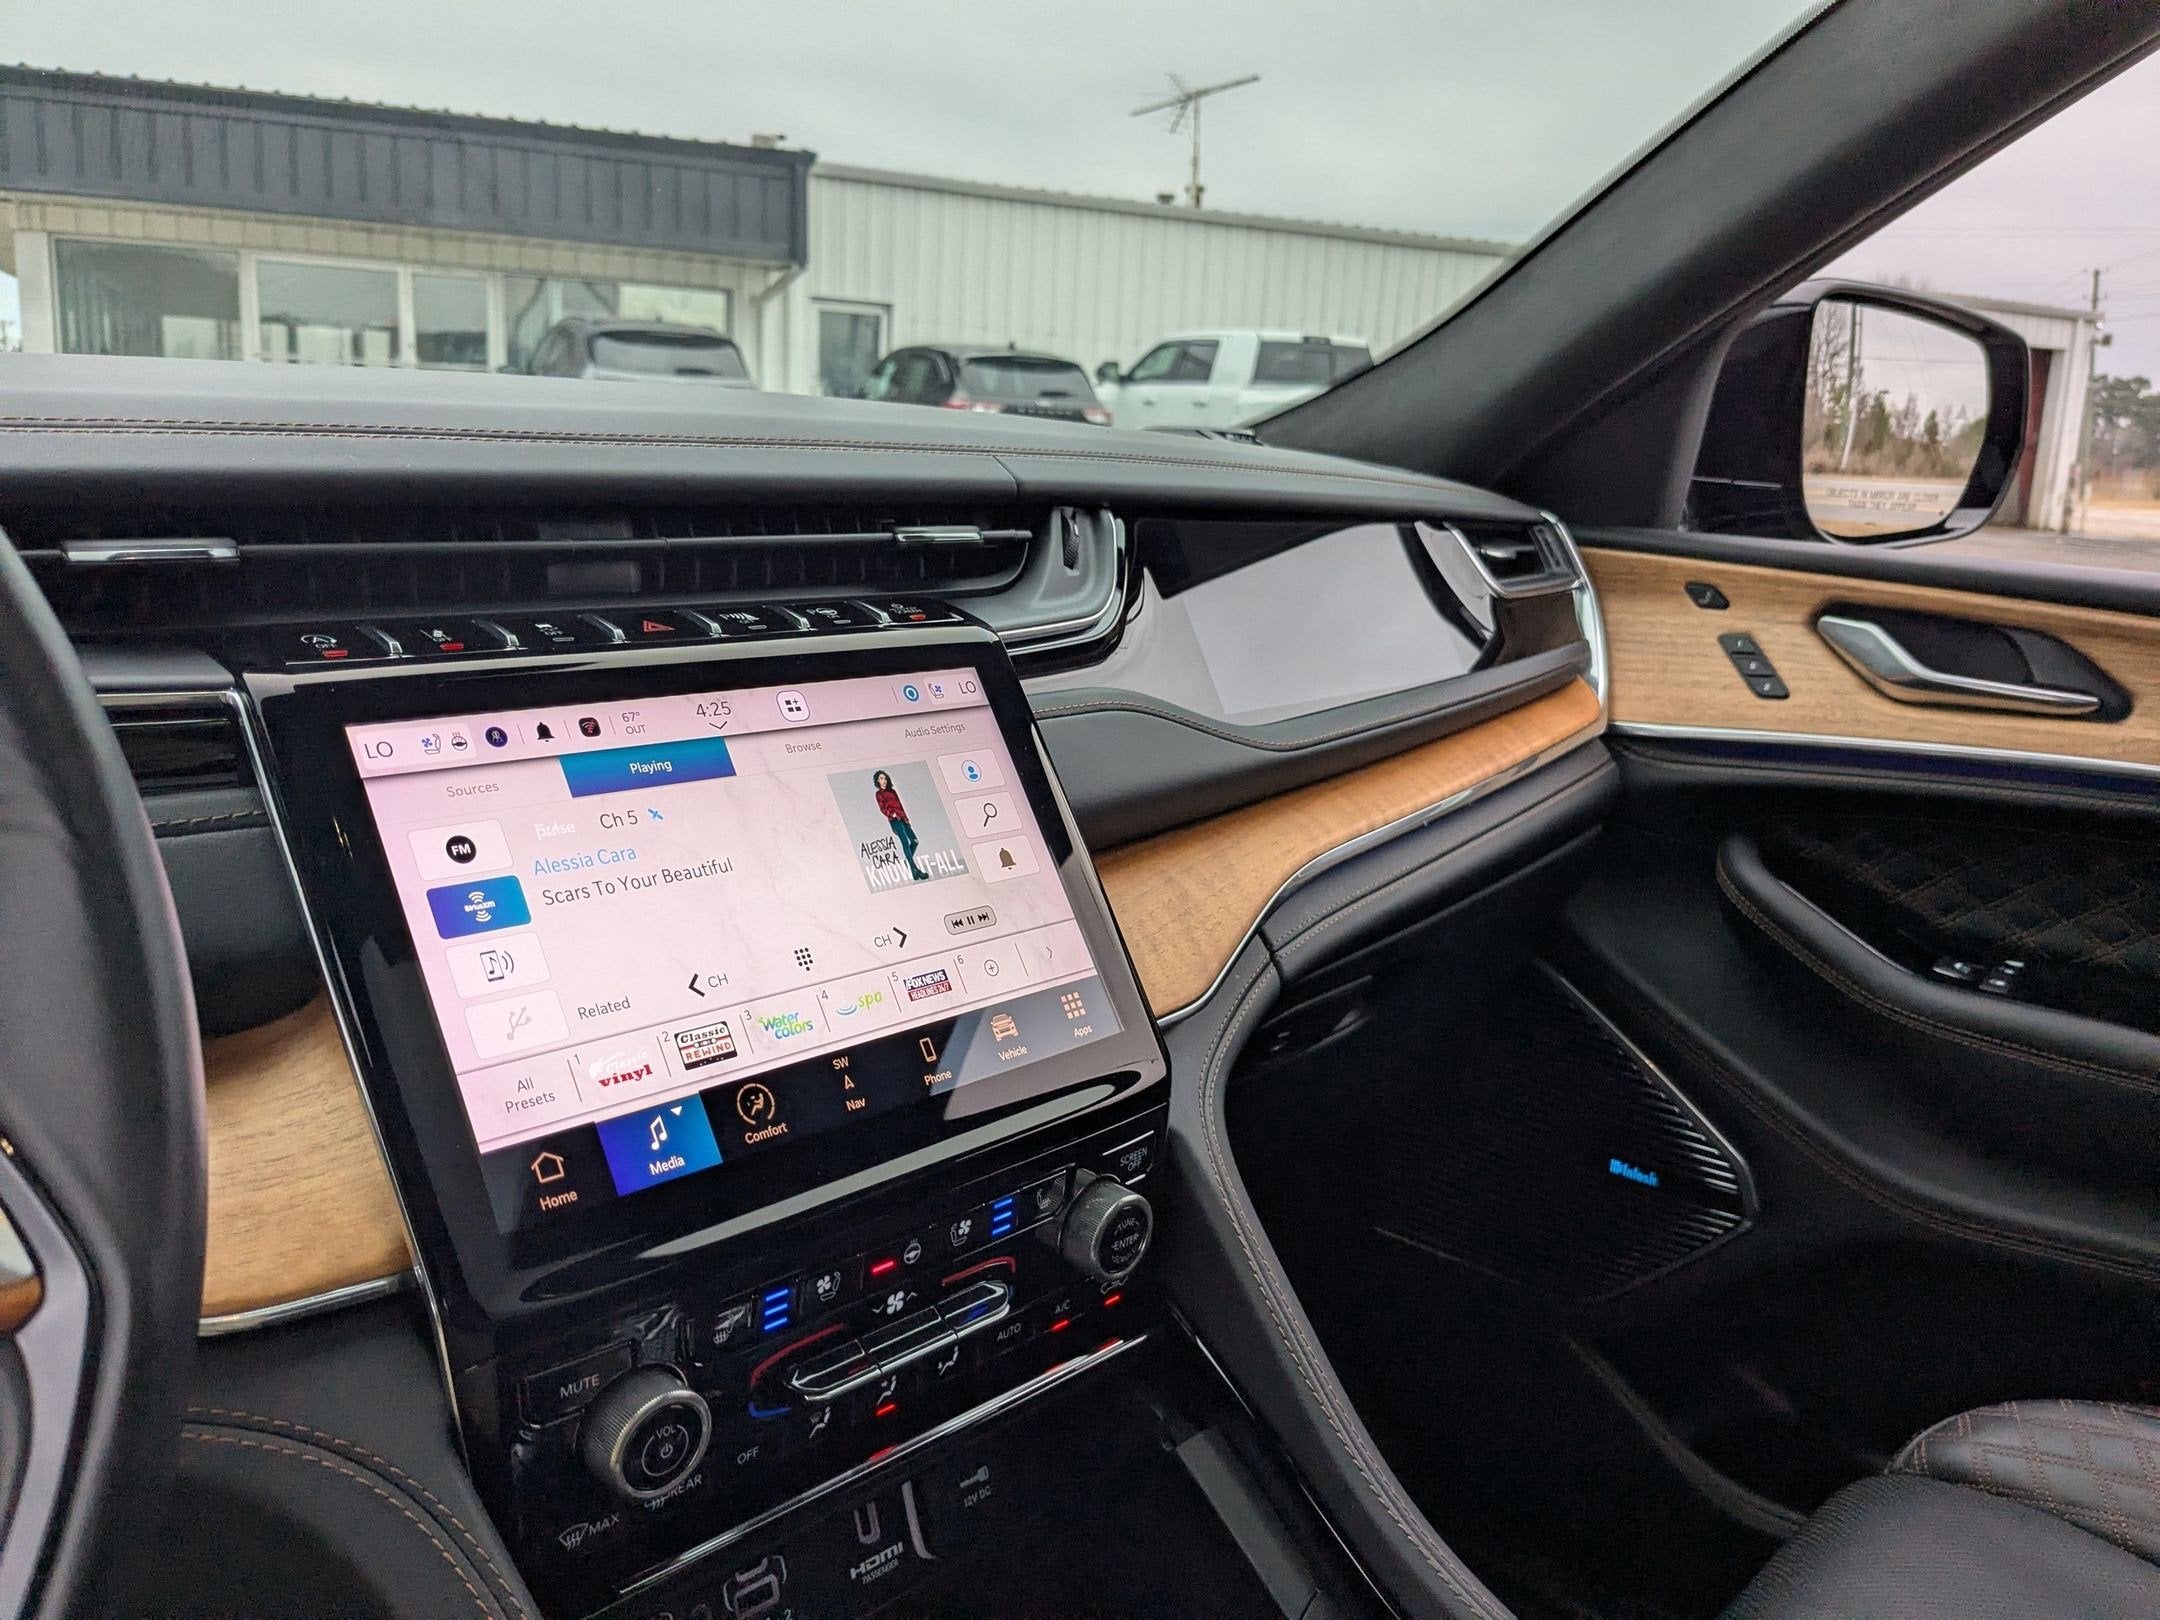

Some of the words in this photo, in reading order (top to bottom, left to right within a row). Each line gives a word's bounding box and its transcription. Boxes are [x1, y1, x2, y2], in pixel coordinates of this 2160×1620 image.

[959, 681, 977, 695] LO
[696, 700, 732, 718] 4:25
[625, 724, 647, 735] OUT
[904, 725, 931, 738] Audio
[930, 721, 966, 736] Settings
[364, 741, 394, 760] LO
[785, 740, 822, 754] Browse
[629, 758, 673, 775] Playing
[446, 781, 500, 799] Sources
[599, 812, 625, 829] Ch
[626, 809, 639, 826] 5
[450, 843, 472, 856] FM
[861, 836, 897, 860] ALESSIA
[534, 851, 594, 876] Alessia
[597, 846, 637, 866] Cara
[872, 851, 901, 870] CARA
[542, 883, 591, 907] Scars
[593, 880, 616, 896] To
[616, 872, 659, 892] Your
[662, 856, 734, 884] Beautiful
[873, 934, 893, 949] CH
[956, 953, 965, 965] 6
[707, 973, 729, 989] CH
[891, 971, 899, 982] 5
[820, 989, 829, 1002] 4
[857, 991, 884, 1010] spa
[577, 996, 631, 1021] Related
[745, 1009, 753, 1021] 3
[661, 1030, 671, 1043] 2
[680, 1025, 726, 1044] Classic
[774, 1020, 814, 1040] colors
[1074, 1025, 1093, 1038] Apps
[574, 1053, 581, 1065] 1
[685, 1041, 732, 1061] REWIND
[998, 1043, 1028, 1062] Vehicle
[832, 1056, 849, 1070] SW
[598, 1063, 653, 1088] vinyl
[923, 1068, 953, 1086] Phone
[517, 1077, 535, 1093] All
[505, 1090, 556, 1114] Presets
[846, 1097, 866, 1111] Nav
[744, 1121, 789, 1144] Comfort
[649, 1155, 686, 1175] Media
[1119, 1147, 1148, 1168] SCREEN
[1127, 1158, 1142, 1170] OFF
[539, 1188, 579, 1211] Home
[1054, 1299, 1071, 1315] A/C
[997, 1322, 1022, 1341] AUTO
[559, 1374, 600, 1399] MUTE
[655, 1425, 677, 1439] VOL
[736, 1447, 761, 1465] OFF
[588, 1513, 621, 1537] MAX
